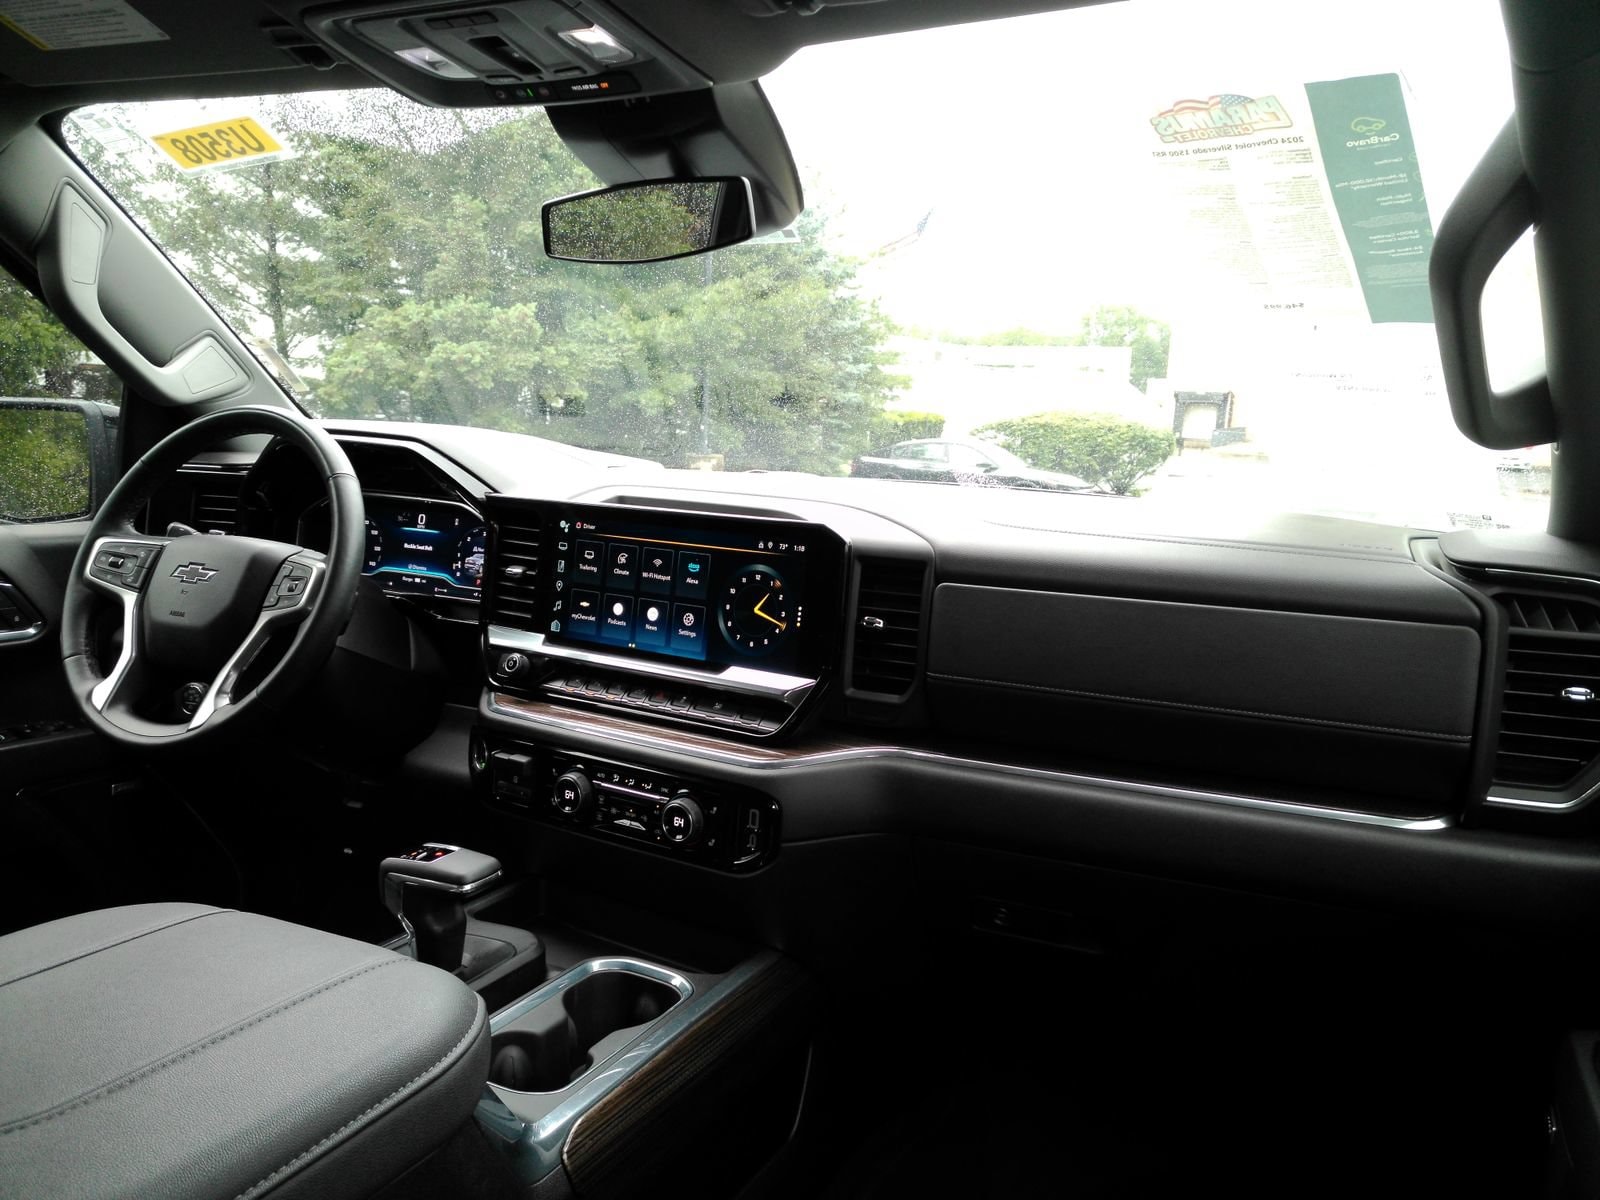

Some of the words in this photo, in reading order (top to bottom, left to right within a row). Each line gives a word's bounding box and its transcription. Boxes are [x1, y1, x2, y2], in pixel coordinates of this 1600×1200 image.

[418, 513, 426, 525] 0
[614, 568, 630, 576] Climate
[654, 573, 671, 581] Hotspot
[686, 577, 699, 585] Alexa
[607, 617, 627, 627] Podcasts
[645, 623, 658, 632] News
[678, 628, 697, 639] Settings
[564, 790, 575, 801] 64
[673, 816, 684, 828] 64
